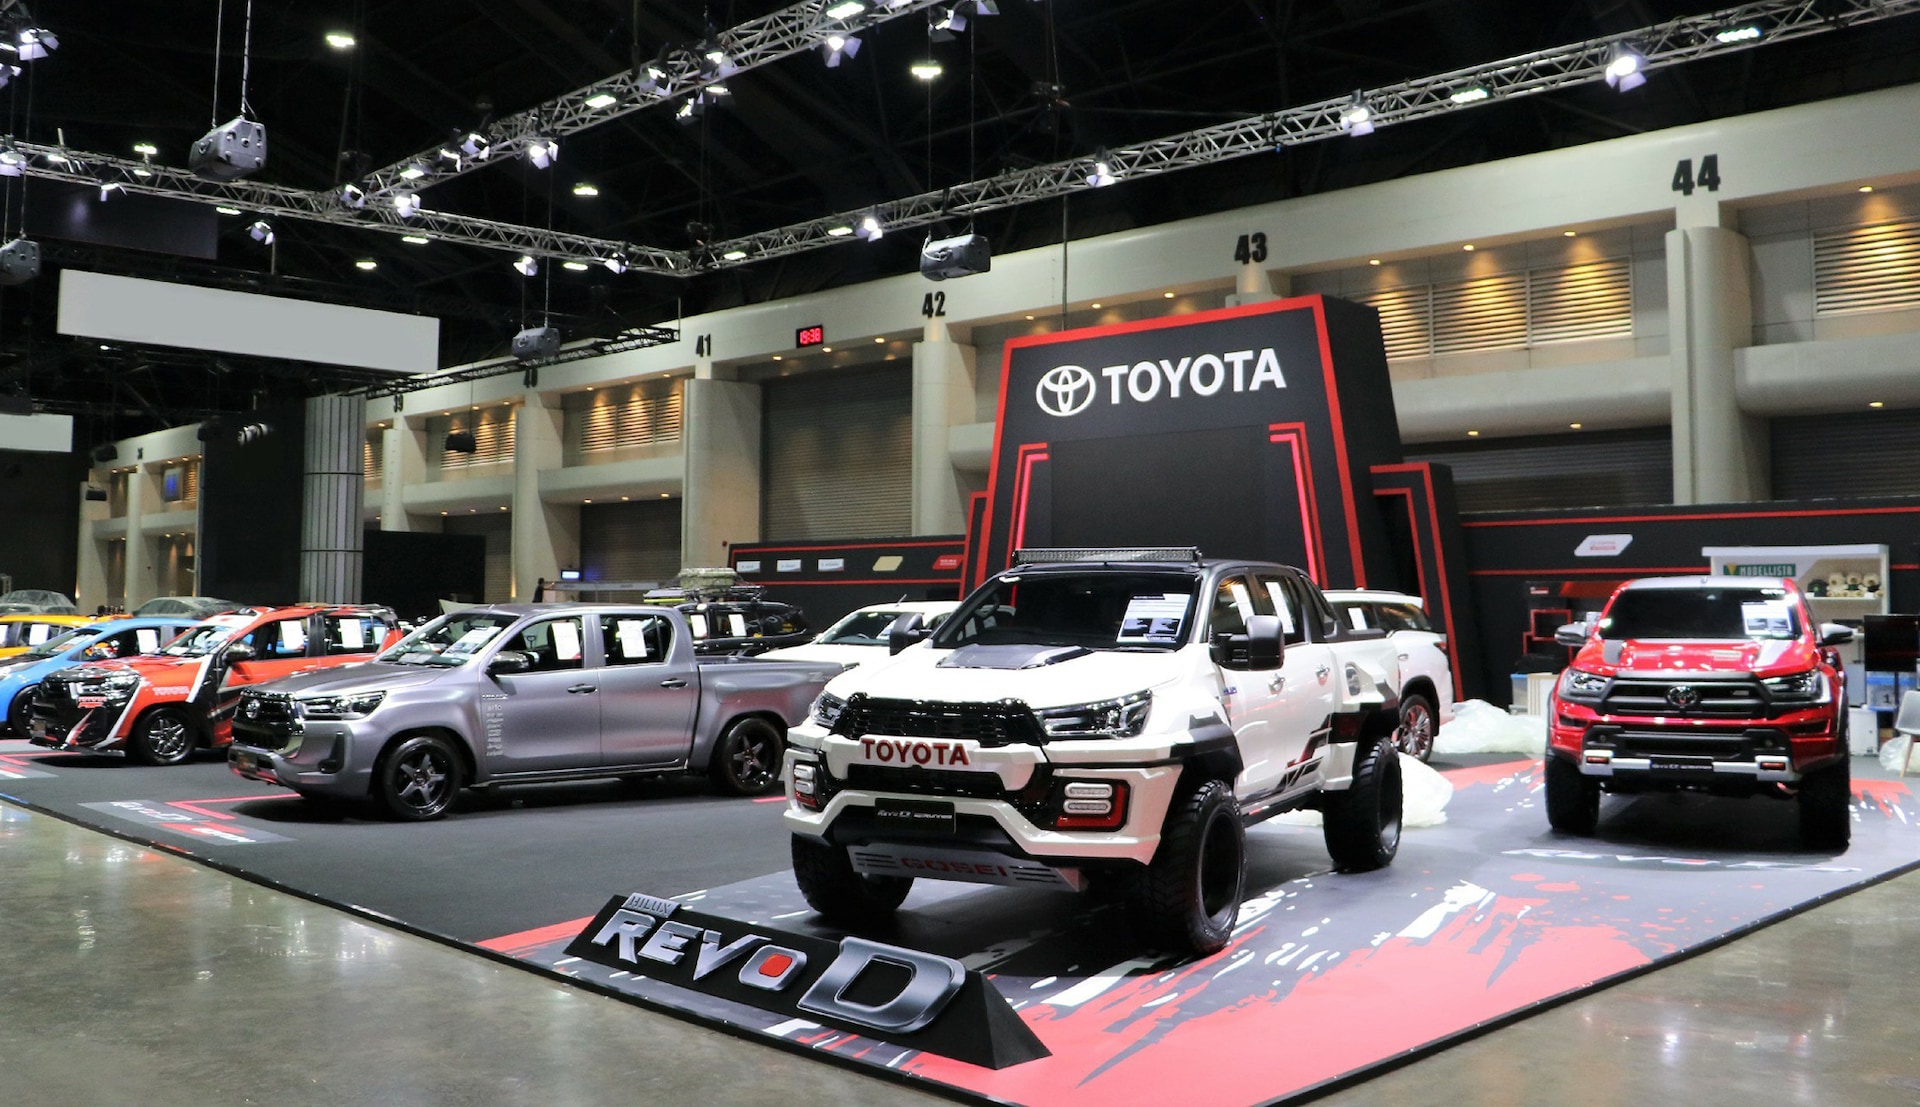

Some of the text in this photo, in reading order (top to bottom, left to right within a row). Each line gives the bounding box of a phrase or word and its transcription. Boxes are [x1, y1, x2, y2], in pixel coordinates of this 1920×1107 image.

[1671, 153, 1721, 197] 44
[1234, 232, 1267, 265] 43
[922, 291, 946, 319] 42
[695, 333, 711, 358] 41
[1101, 347, 1288, 405] TOYOTA
[860, 738, 970, 766] TOYOTA
[900, 857, 1008, 877] GOSEI
[628, 895, 674, 915] HILUX
[796, 935, 967, 1035] D
